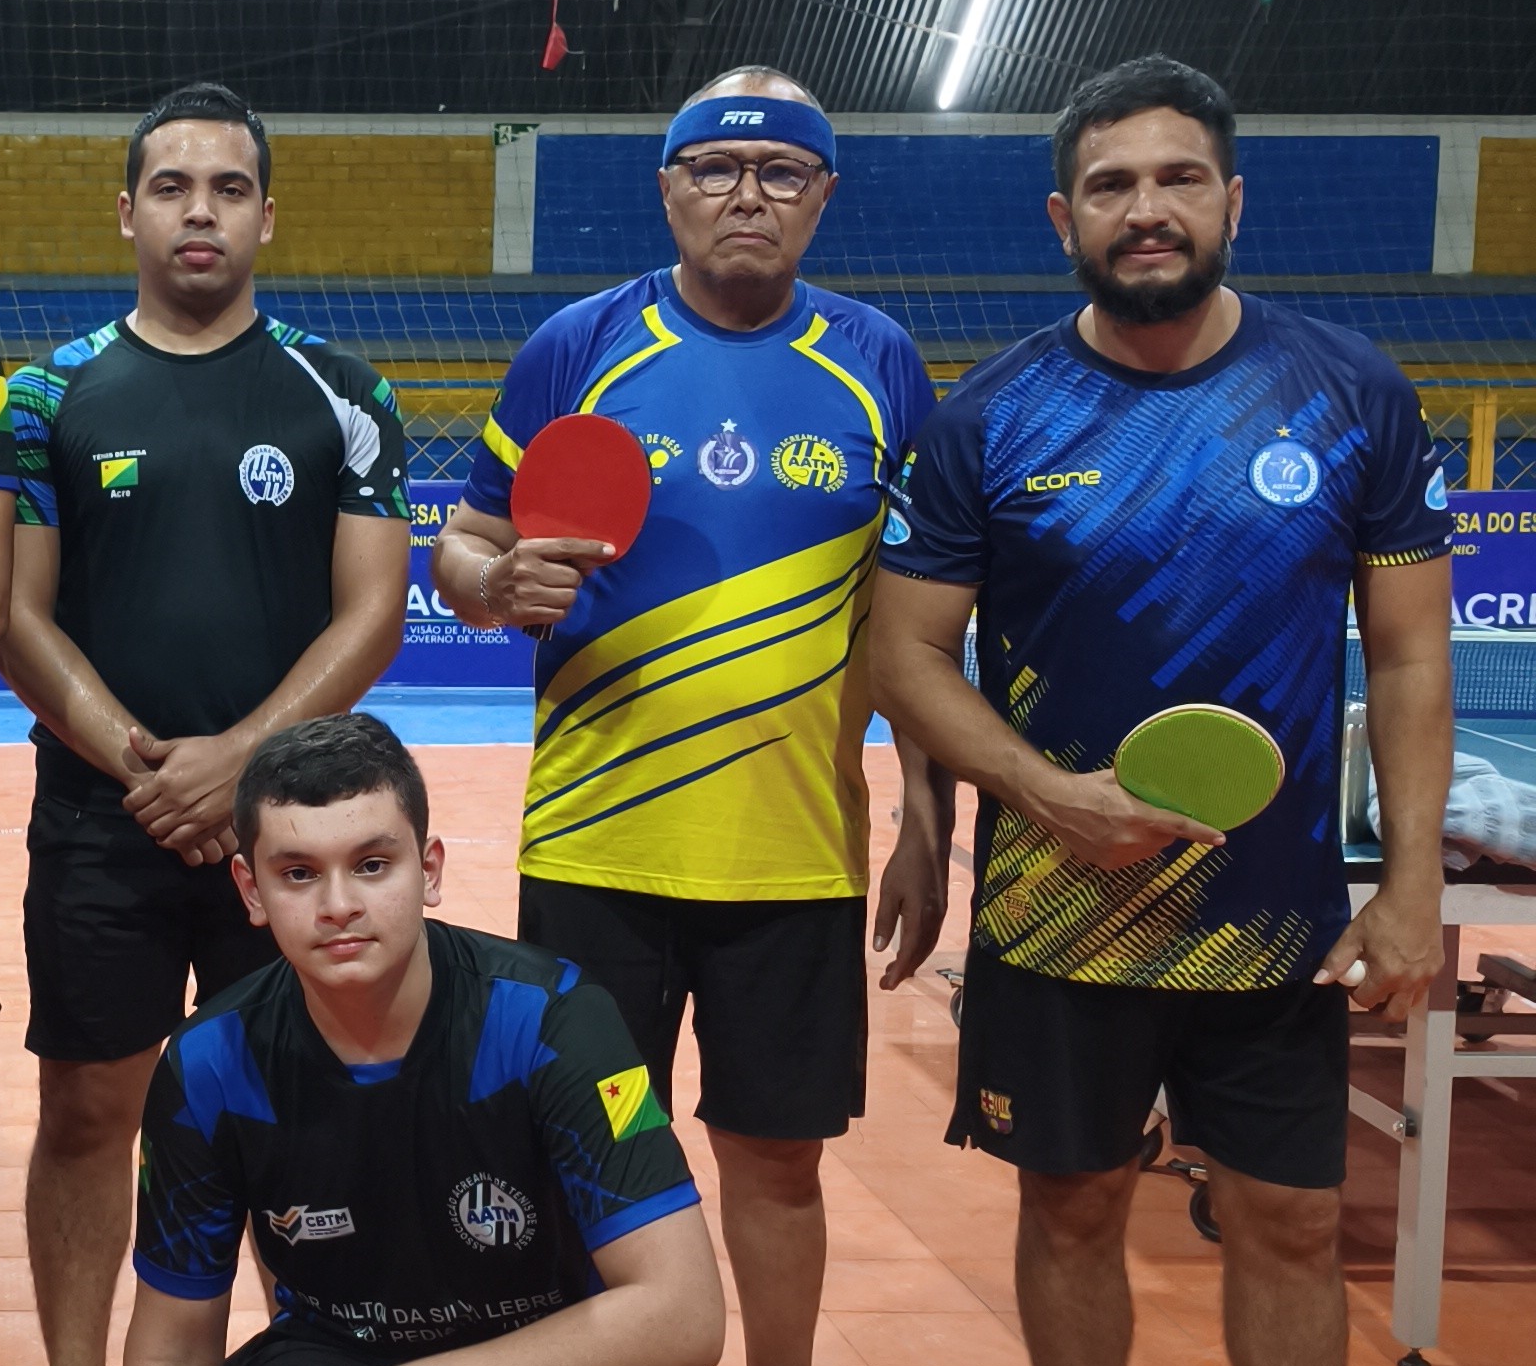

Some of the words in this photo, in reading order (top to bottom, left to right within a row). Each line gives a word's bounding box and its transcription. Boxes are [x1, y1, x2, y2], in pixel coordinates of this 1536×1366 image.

[821, 438, 832, 447] DE
[789, 456, 834, 471] AATM
[250, 470, 282, 483] AATM
[1487, 512, 1514, 533] DO
[410, 624, 441, 634] VISÃO
[445, 626, 458, 634] DE
[403, 635, 453, 644] GOVERNO
[457, 635, 470, 644] DE
[494, 1177, 507, 1191] DE
[509, 1186, 534, 1211] TENIS
[526, 1212, 537, 1225] DE
[306, 1212, 347, 1227] CBTM
[467, 1206, 519, 1224] AATM
[392, 1308, 426, 1324] DA
[486, 1289, 563, 1319] LEBRE
